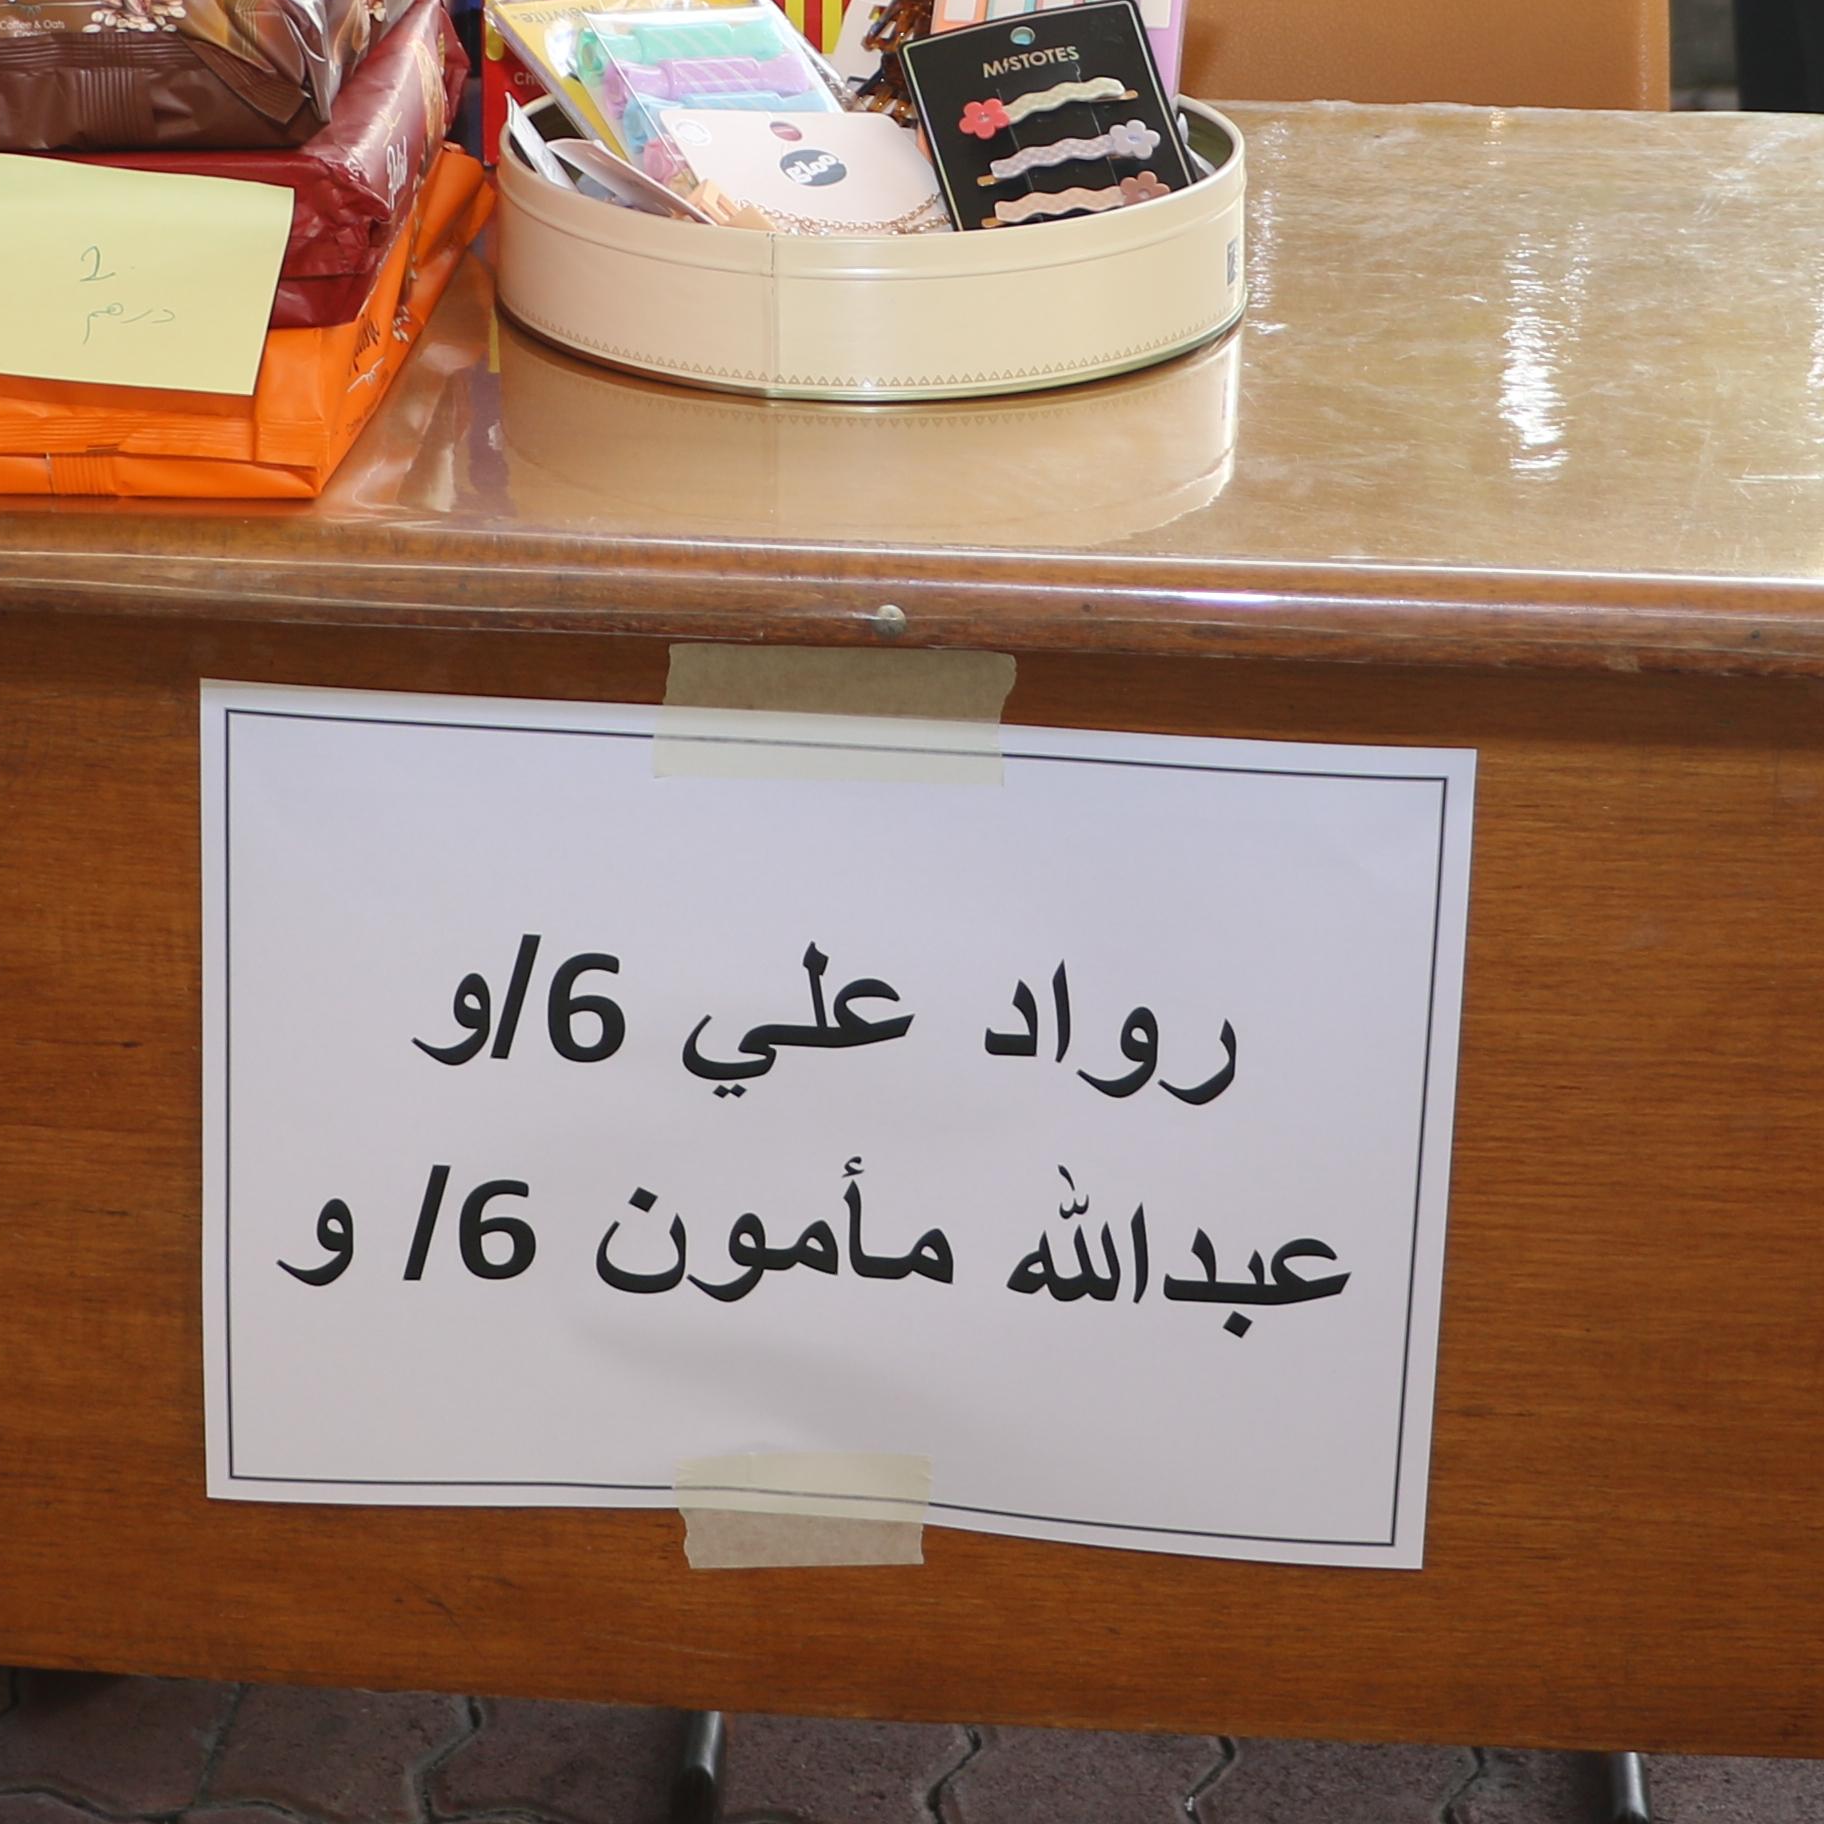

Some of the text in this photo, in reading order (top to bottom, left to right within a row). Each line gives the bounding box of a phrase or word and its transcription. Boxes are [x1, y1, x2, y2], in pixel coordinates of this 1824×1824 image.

[43, 19, 66, 30] Oats
[683, 942, 913, 1098] علي
[985, 962, 1236, 1105] رواد
[597, 1157, 953, 1302] مأمون
[1007, 1166, 1350, 1338] عبدالله
